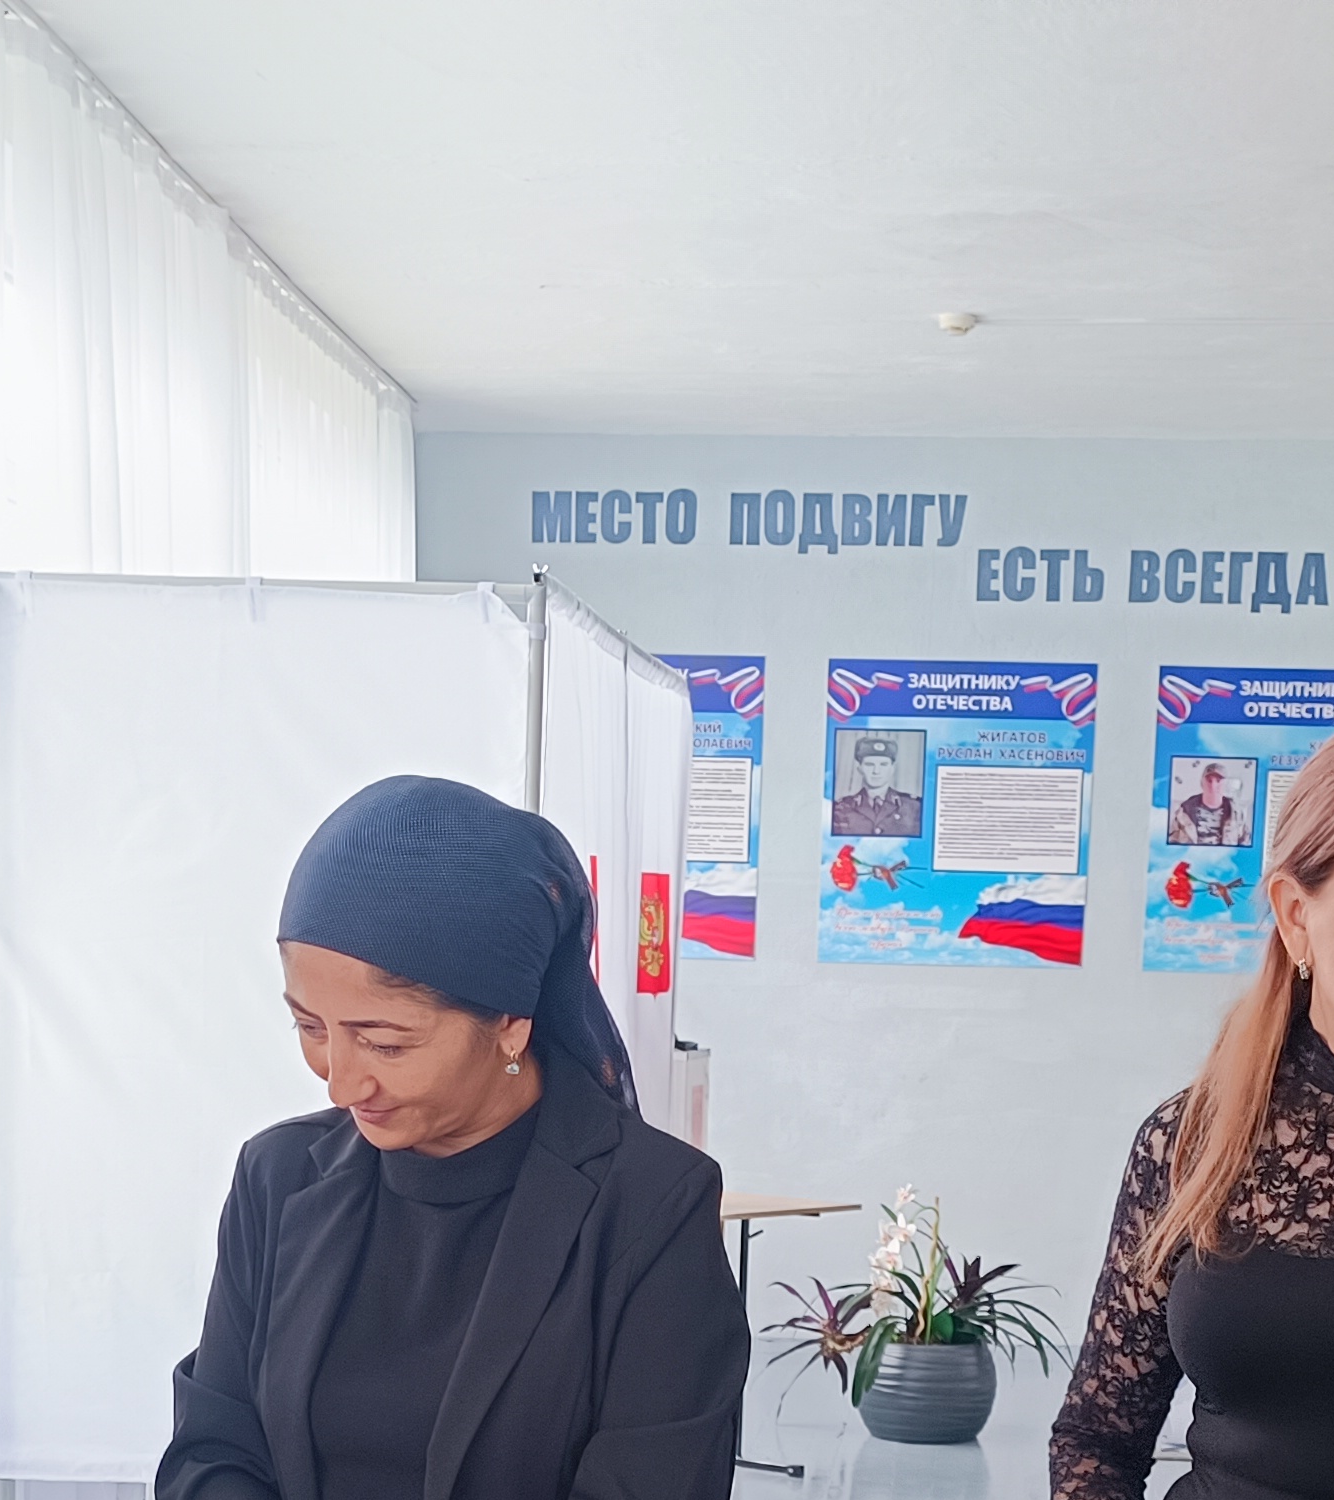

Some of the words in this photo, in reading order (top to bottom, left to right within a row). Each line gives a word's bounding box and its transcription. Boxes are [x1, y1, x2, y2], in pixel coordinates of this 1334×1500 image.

[531, 488, 698, 545] МЕСТО
[729, 489, 968, 554] ПОДВИГУ
[976, 546, 1105, 602] ЕСТЬ
[1128, 548, 1329, 614] ВСЕГДА
[907, 673, 1021, 691] ЗАЩИТНИКУ
[912, 695, 1013, 712] ОТЕЧЕСТВА
[694, 720, 722, 734] КИЙ
[693, 738, 752, 749] ОЛАЕВИЧ
[977, 731, 1047, 743] ЖИГАТОВ
[937, 747, 993, 758] РУСЛАН
[998, 749, 1086, 761] ХАСЕНОВИЧ
